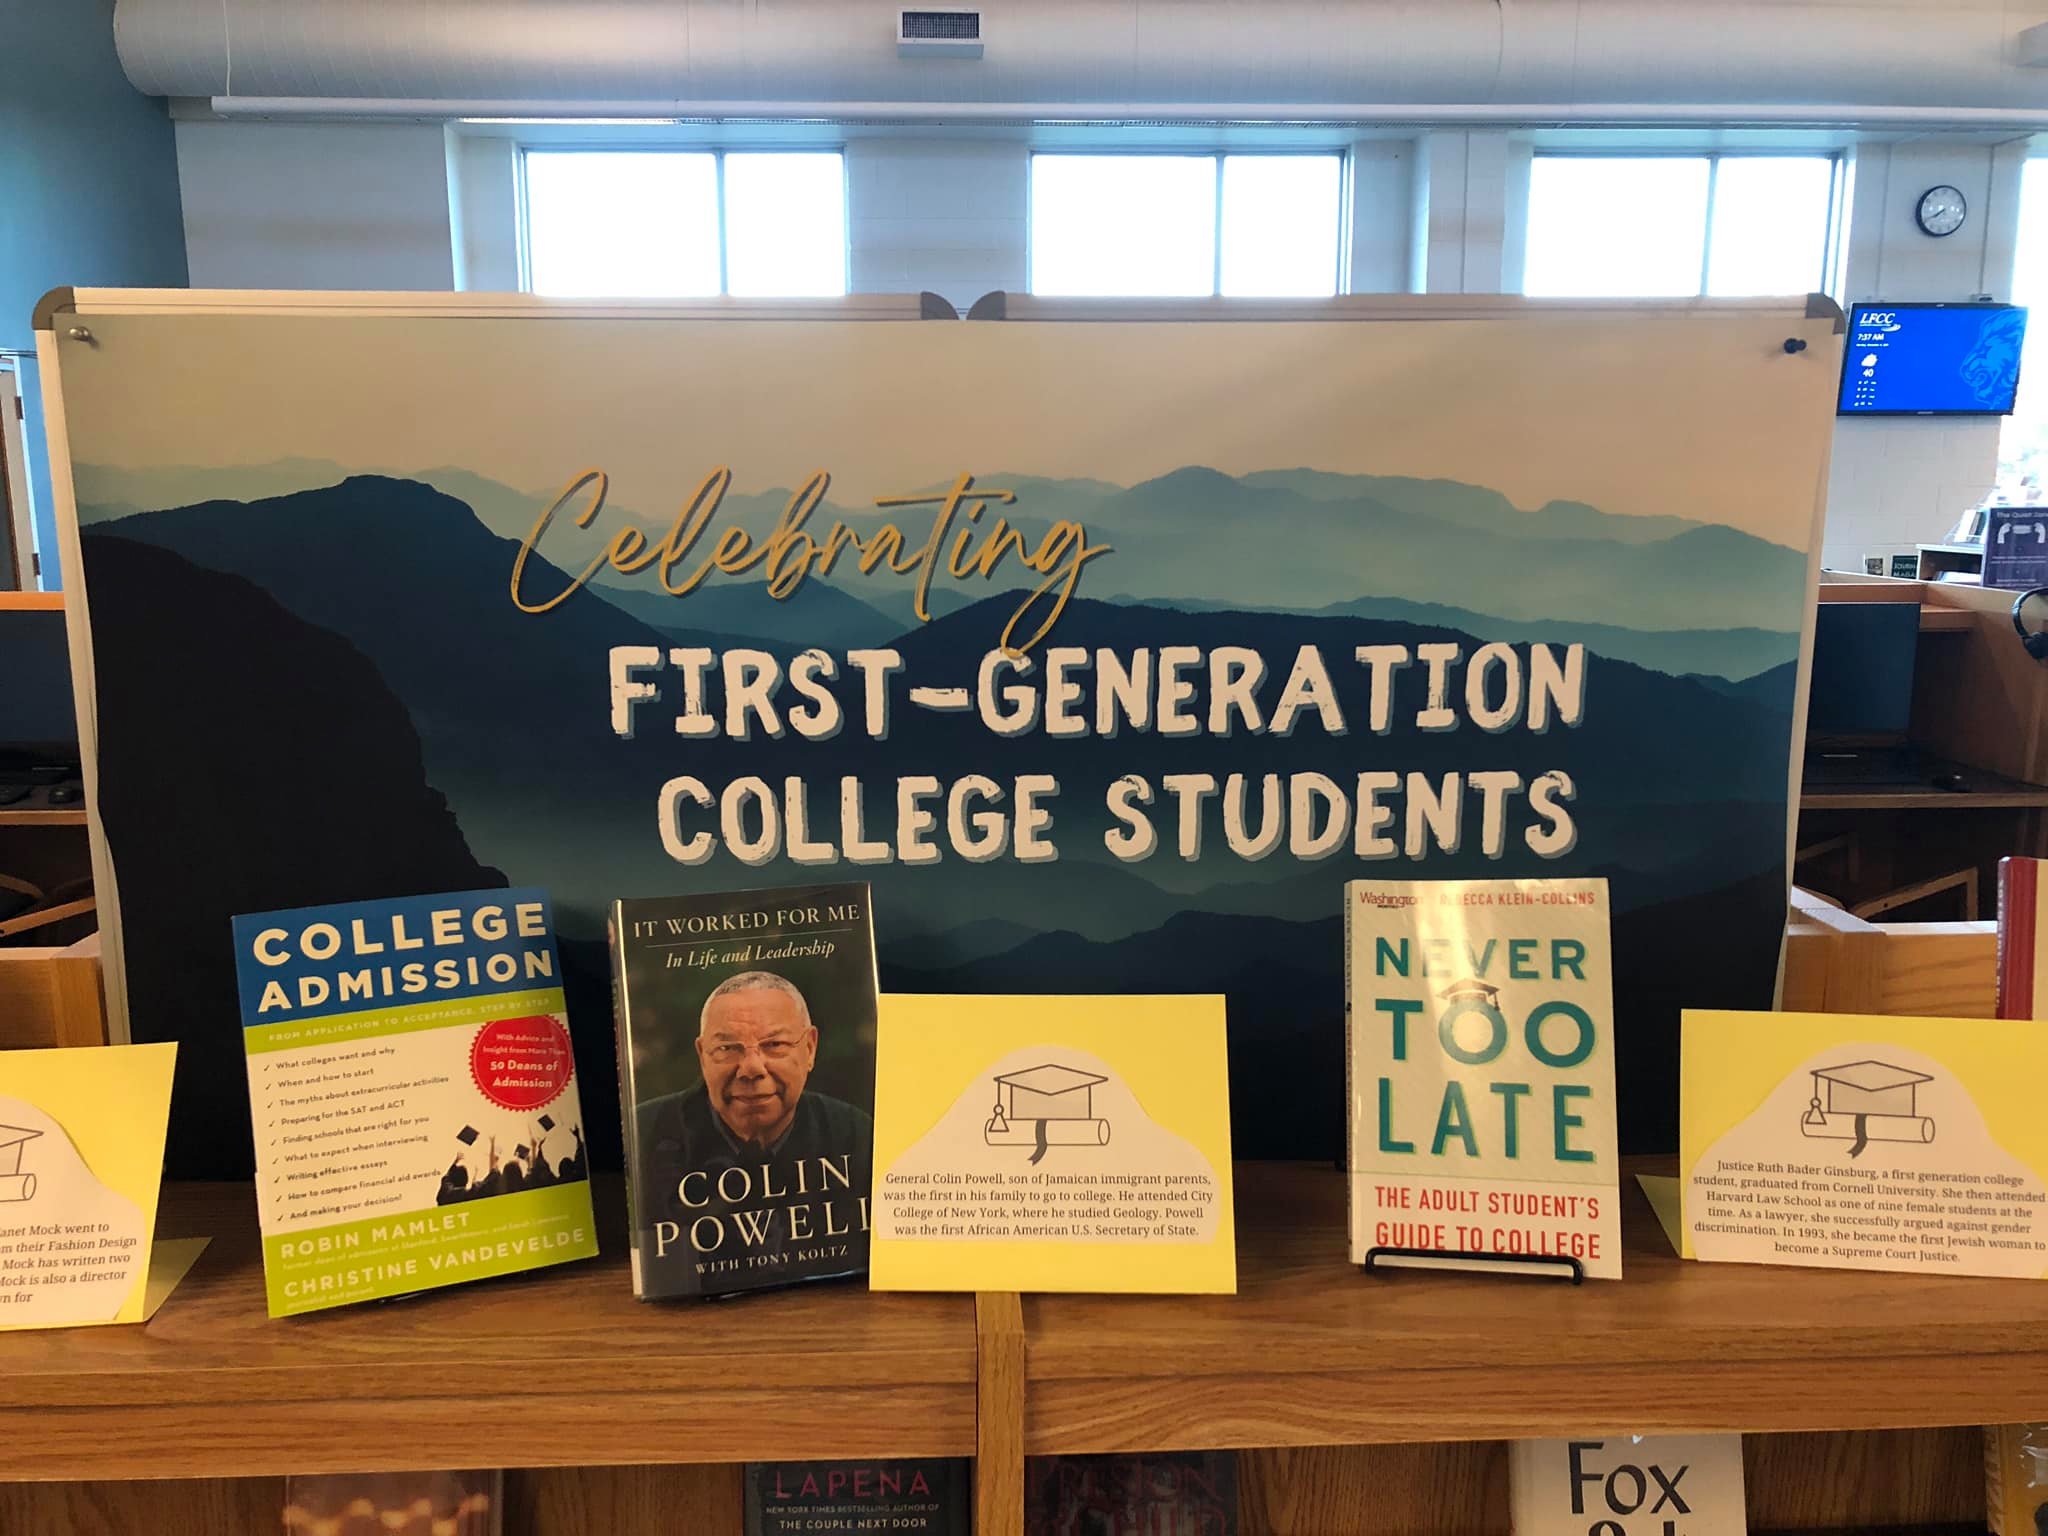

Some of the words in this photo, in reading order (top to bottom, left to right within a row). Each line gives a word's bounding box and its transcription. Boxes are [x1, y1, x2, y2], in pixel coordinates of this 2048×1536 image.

[1860, 312, 1896, 324] LFCC
[510, 466, 1112, 658] Celebrating
[608, 642, 1588, 740] FIRST-GENERATION
[656, 772, 1060, 868] COLLEGE
[1104, 768, 1580, 864] STUDENTS
[1360, 892, 1422, 908] Washingto
[1498, 892, 1596, 906] KLEIN-COLLINS
[252, 902, 548, 968] COLLEGE
[634, 921, 657, 938] IT
[666, 911, 768, 934] WORKED
[776, 907, 820, 926] FOR
[828, 904, 860, 921] ME
[666, 952, 682, 968] In
[687, 948, 718, 969] Life
[721, 945, 752, 963] and
[755, 938, 835, 960] Leadership
[256, 948, 554, 1014] ADMISSION
[1374, 996, 1596, 1070] TOO
[277, 1079, 303, 1088] When
[305, 1074, 321, 1085] and
[353, 1067, 374, 1077] start
[490, 1060, 505, 1071] 50
[507, 1059, 543, 1071] Deans
[545, 1060, 558, 1071] of
[492, 1076, 552, 1088] Admission
[280, 1114, 321, 1126] Preparing
[321, 1111, 333, 1119] for
[335, 1109, 349, 1117] the
[350, 1105, 367, 1115] SAT
[368, 1102, 385, 1112] and
[386, 1098, 405, 1109] ACT
[1378, 1076, 1598, 1164] LATE
[286, 1171, 318, 1181] Writing
[319, 1165, 358, 1176] effective
[360, 1160, 388, 1170] essays
[676, 1154, 852, 1210] COLIN
[885, 1172, 930, 1184] General
[932, 1172, 962, 1184] Colin
[965, 1172, 1005, 1185] Powell,
[1008, 1175, 1028, 1184] son
[1031, 1173, 1043, 1184] of
[1045, 1173, 1098, 1187] Jamaican
[1100, 1173, 1161, 1187] immigrant
[1164, 1174, 1211, 1187] parents,
[1717, 1159, 1754, 1172] Justice
[1756, 1161, 1784, 1173] Ruth
[1786, 1163, 1821, 1176] Bader
[1823, 1165, 1879, 1181] Ginsburg,
[1881, 1170, 1888, 1179] a
[1891, 1168, 1915, 1180] first
[1918, 1172, 1981, 1184] generation
[1983, 1173, 2024, 1188] college
[883, 1192, 906, 1200] was
[908, 1189, 926, 1201] the
[929, 1189, 952, 1201] first
[955, 1190, 967, 1201] in
[970, 1189, 987, 1201] his
[990, 1189, 1026, 1204] family
[1029, 1191, 1040, 1201] to
[1042, 1192, 1056, 1204] go
[1059, 1191, 1070, 1201] to
[1073, 1189, 1115, 1204] college.
[1118, 1190, 1134, 1201] He
[1137, 1190, 1188, 1201] attended
[1190, 1190, 1213, 1204] City
[1374, 1185, 1411, 1209] THE
[1418, 1188, 1480, 1213] ADULT
[1488, 1192, 1599, 1219] STUDENT'S
[1693, 1175, 1738, 1188] student,
[1740, 1177, 1798, 1190] graduated
[1801, 1179, 1830, 1192] from
[1832, 1182, 1874, 1194] Cornell
[1876, 1184, 1938, 1199] University.
[1942, 1187, 1963, 1199] She
[1965, 1188, 1992, 1200] then
[1994, 1191, 2046, 1203] attended
[893, 1206, 934, 1221] College
[936, 1206, 949, 1218] of
[951, 1207, 976, 1218] New
[979, 1206, 1009, 1219] York,
[1012, 1206, 1048, 1218] where
[1051, 1206, 1065, 1218] he
[1068, 1207, 1110, 1218] studied
[1112, 1207, 1162, 1221] Geology.
[1165, 1207, 1204, 1218] Powell
[1706, 1190, 1753, 1203] Harvard
[1756, 1193, 1781, 1204] Law
[1783, 1194, 1822, 1207] School
[1824, 1199, 1837, 1208] as
[1839, 1200, 1861, 1209] one
[1863, 1199, 1875, 1210] of
[1877, 1200, 1903, 1211] nine
[1906, 1201, 1945, 1214] female
[1947, 1204, 1997, 1216] students
[1999, 1207, 2011, 1216] at
[2014, 1207, 2032, 1218] the
[0, 1227, 26, 1238] anet
[28, 1223, 62, 1236] Mock
[64, 1223, 95, 1234] went
[97, 1223, 110, 1232] to
[280, 1231, 359, 1259] ROBIN
[372, 1211, 470, 1243] MAMLET
[894, 1226, 917, 1235] was
[920, 1223, 938, 1235] the
[940, 1223, 964, 1235] first
[967, 1223, 1010, 1236] African
[1012, 1223, 1068, 1236] American
[1071, 1224, 1092, 1236] U.S.
[1095, 1224, 1150, 1238] Secretary
[1152, 1223, 1165, 1236] of
[1167, 1224, 1199, 1236] State.
[1374, 1220, 1446, 1250] GUIDE
[1454, 1226, 1484, 1252] TO
[1492, 1228, 1602, 1260] COLLEGE
[16, 1241, 45, 1253] their
[47, 1239, 95, 1251] Fashion
[98, 1237, 137, 1249] Design
[695, 1258, 738, 1274] WITH
[748, 1252, 788, 1268] TONY
[798, 1244, 848, 1261] KOLTZ
[2, 1257, 34, 1270] Mock
[37, 1257, 59, 1268] has
[62, 1255, 106, 1266] written
[108, 1254, 131, 1264] two
[284, 1259, 418, 1297] CHRISTINE
[428, 1228, 584, 1270] VANDEVELDE
[28, 1274, 40, 1285] is
[41, 1272, 67, 1285] also
[68, 1274, 76, 1283] a
[79, 1271, 127, 1282] director
[14, 1291, 34, 1303] for
[774, 1468, 932, 1500] LAPENA
[1568, 1440, 1692, 1516] Fox
[779, 1519, 801, 1530] THE
[806, 1519, 852, 1529] COUPLE
[857, 1518, 888, 1528] NEXT
[892, 1517, 926, 1528] DOOR
